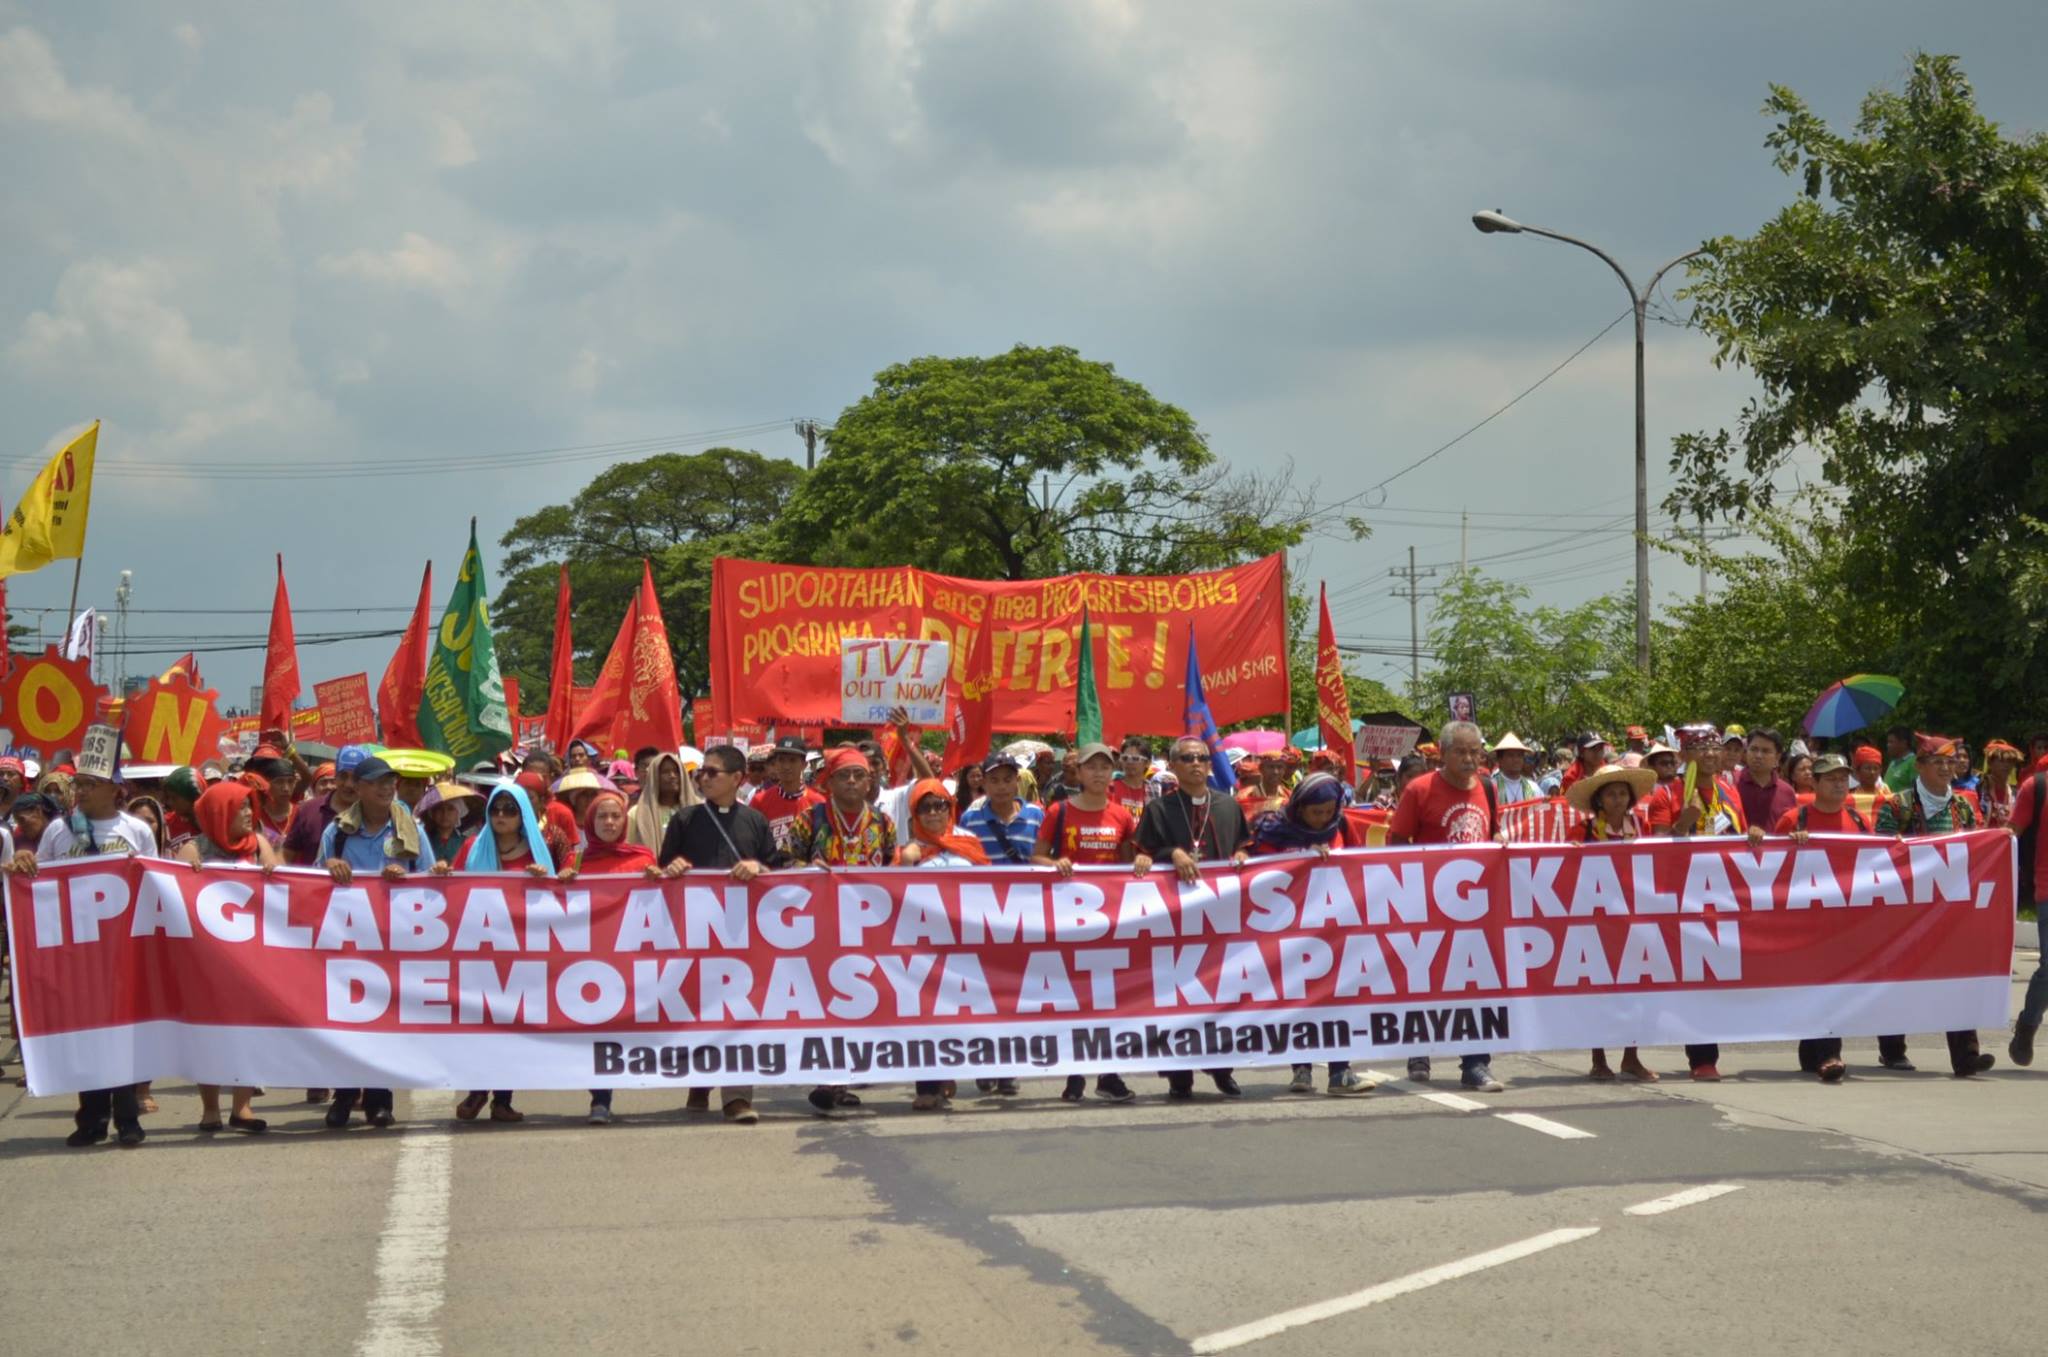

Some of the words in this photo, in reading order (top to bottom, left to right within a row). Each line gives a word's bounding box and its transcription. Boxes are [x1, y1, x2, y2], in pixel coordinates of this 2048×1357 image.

[739, 570, 924, 619] SUPORTAHAN
[932, 590, 987, 622] ang
[993, 593, 1037, 621] mga
[1042, 572, 1238, 619] PROGRESIBONG
[844, 680, 886, 699] OUT
[896, 677, 946, 705] NOW!
[847, 640, 930, 679] TVI
[1241, 655, 1279, 680] SMR
[18, 663, 83, 742] O
[31, 872, 592, 952] IPAGLABAN
[613, 884, 816, 952] ANG
[838, 858, 1490, 947] PAMBANSANG
[1508, 841, 1997, 919] KALAYAAN,
[325, 951, 998, 1025] DEMOKRASYA
[1015, 948, 1130, 1014] AT
[1150, 919, 1743, 1008] KAPAYAPAAN
[593, 1037, 786, 1078] Bagong
[799, 1029, 1058, 1074] Alyansang
[1071, 1004, 1510, 1062] Makabayan-BAYAN
